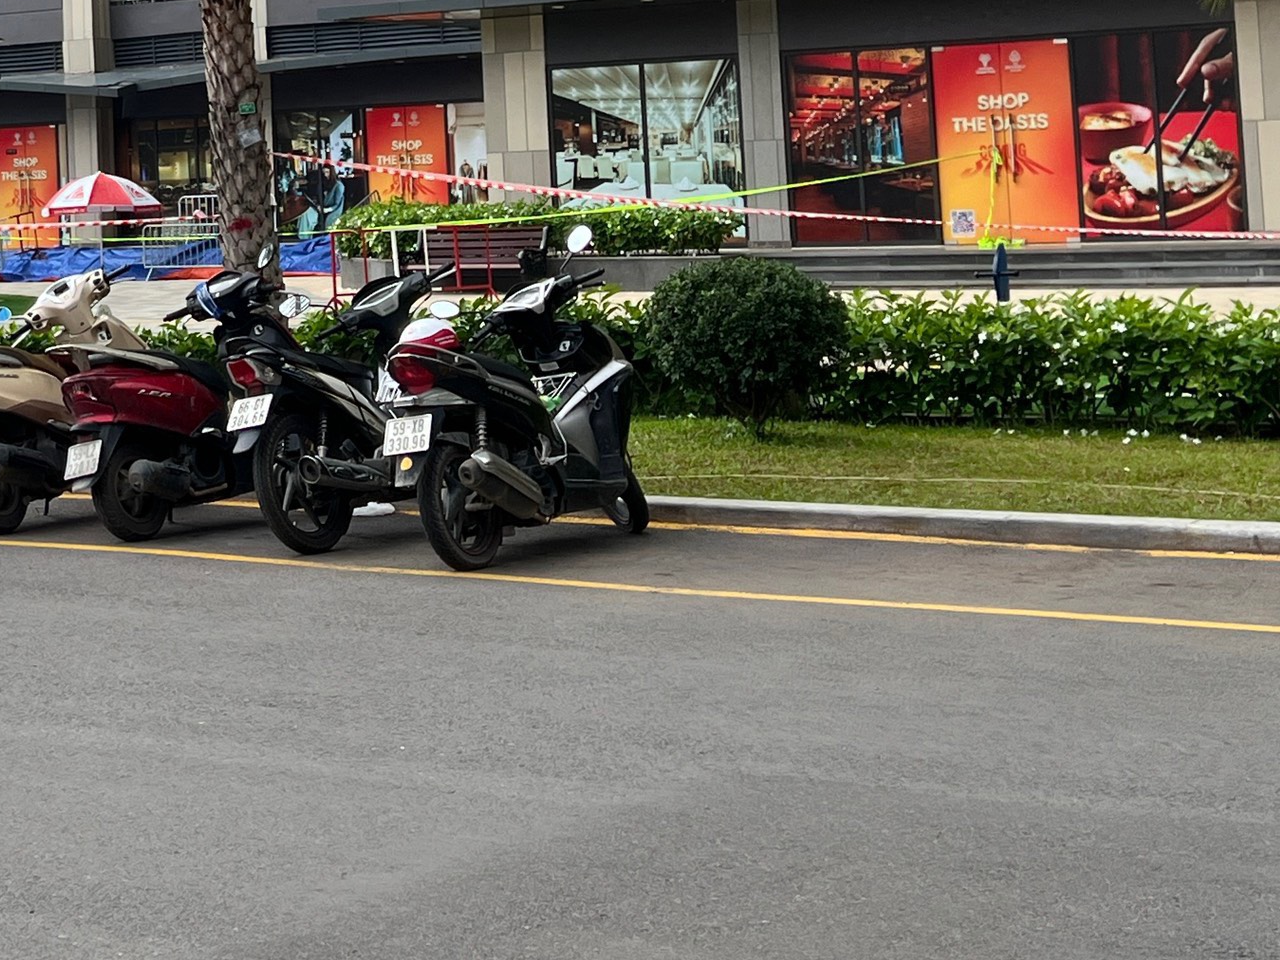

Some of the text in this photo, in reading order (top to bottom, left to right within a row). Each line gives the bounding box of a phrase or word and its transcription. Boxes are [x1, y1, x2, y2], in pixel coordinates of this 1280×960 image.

[977, 92, 1029, 110] SHOP
[952, 116, 987, 133] THE
[391, 139, 423, 152] SHOP
[12, 157, 39, 168] SHOP
[376, 155, 398, 166] THE
[1, 171, 19, 181] THE
